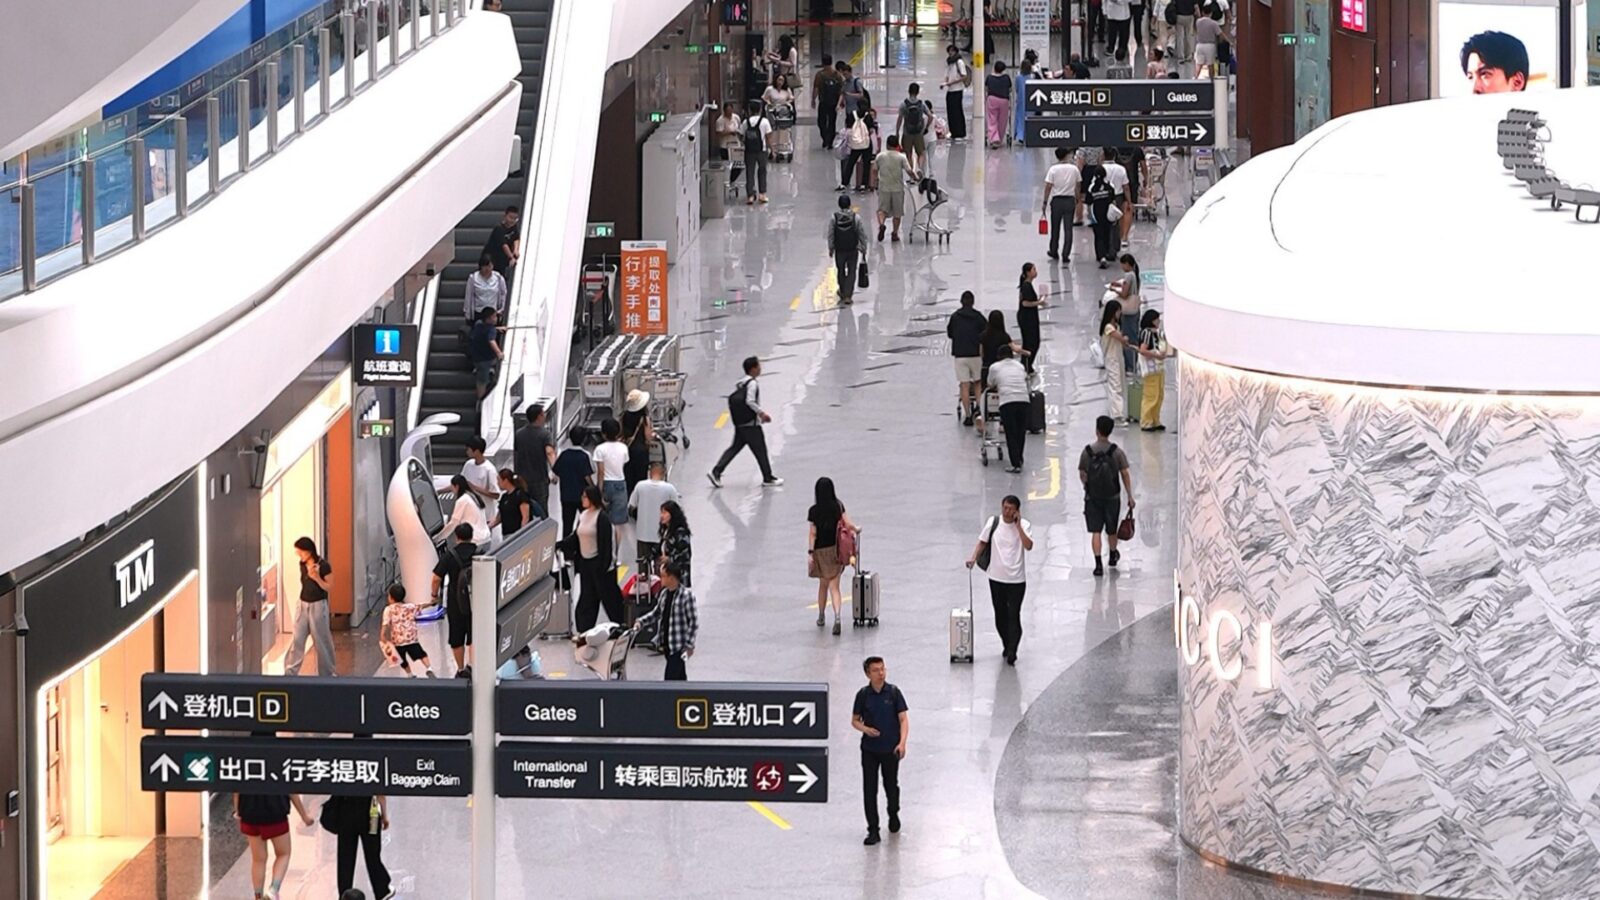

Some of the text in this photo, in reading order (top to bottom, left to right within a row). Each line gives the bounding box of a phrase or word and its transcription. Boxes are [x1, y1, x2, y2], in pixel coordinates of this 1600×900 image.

[1049, 90, 1106, 105] 登机口 D
[1167, 92, 1198, 103] Gates
[1039, 129, 1071, 139] Gates
[1130, 126, 1189, 140] C 登机口
[625, 255, 641, 336] 行李手推
[184, 694, 281, 719] 登机口 D
[388, 702, 440, 719] Gates
[524, 704, 577, 721] Gates
[684, 703, 784, 727] C 登机口
[219, 757, 380, 784] 出口、行李提取
[416, 759, 435, 771] Exit
[513, 760, 588, 774] International
[391, 773, 460, 788] Baggage Claim
[525, 775, 576, 789] Transfer
[615, 764, 749, 788] 转乘国际航班
